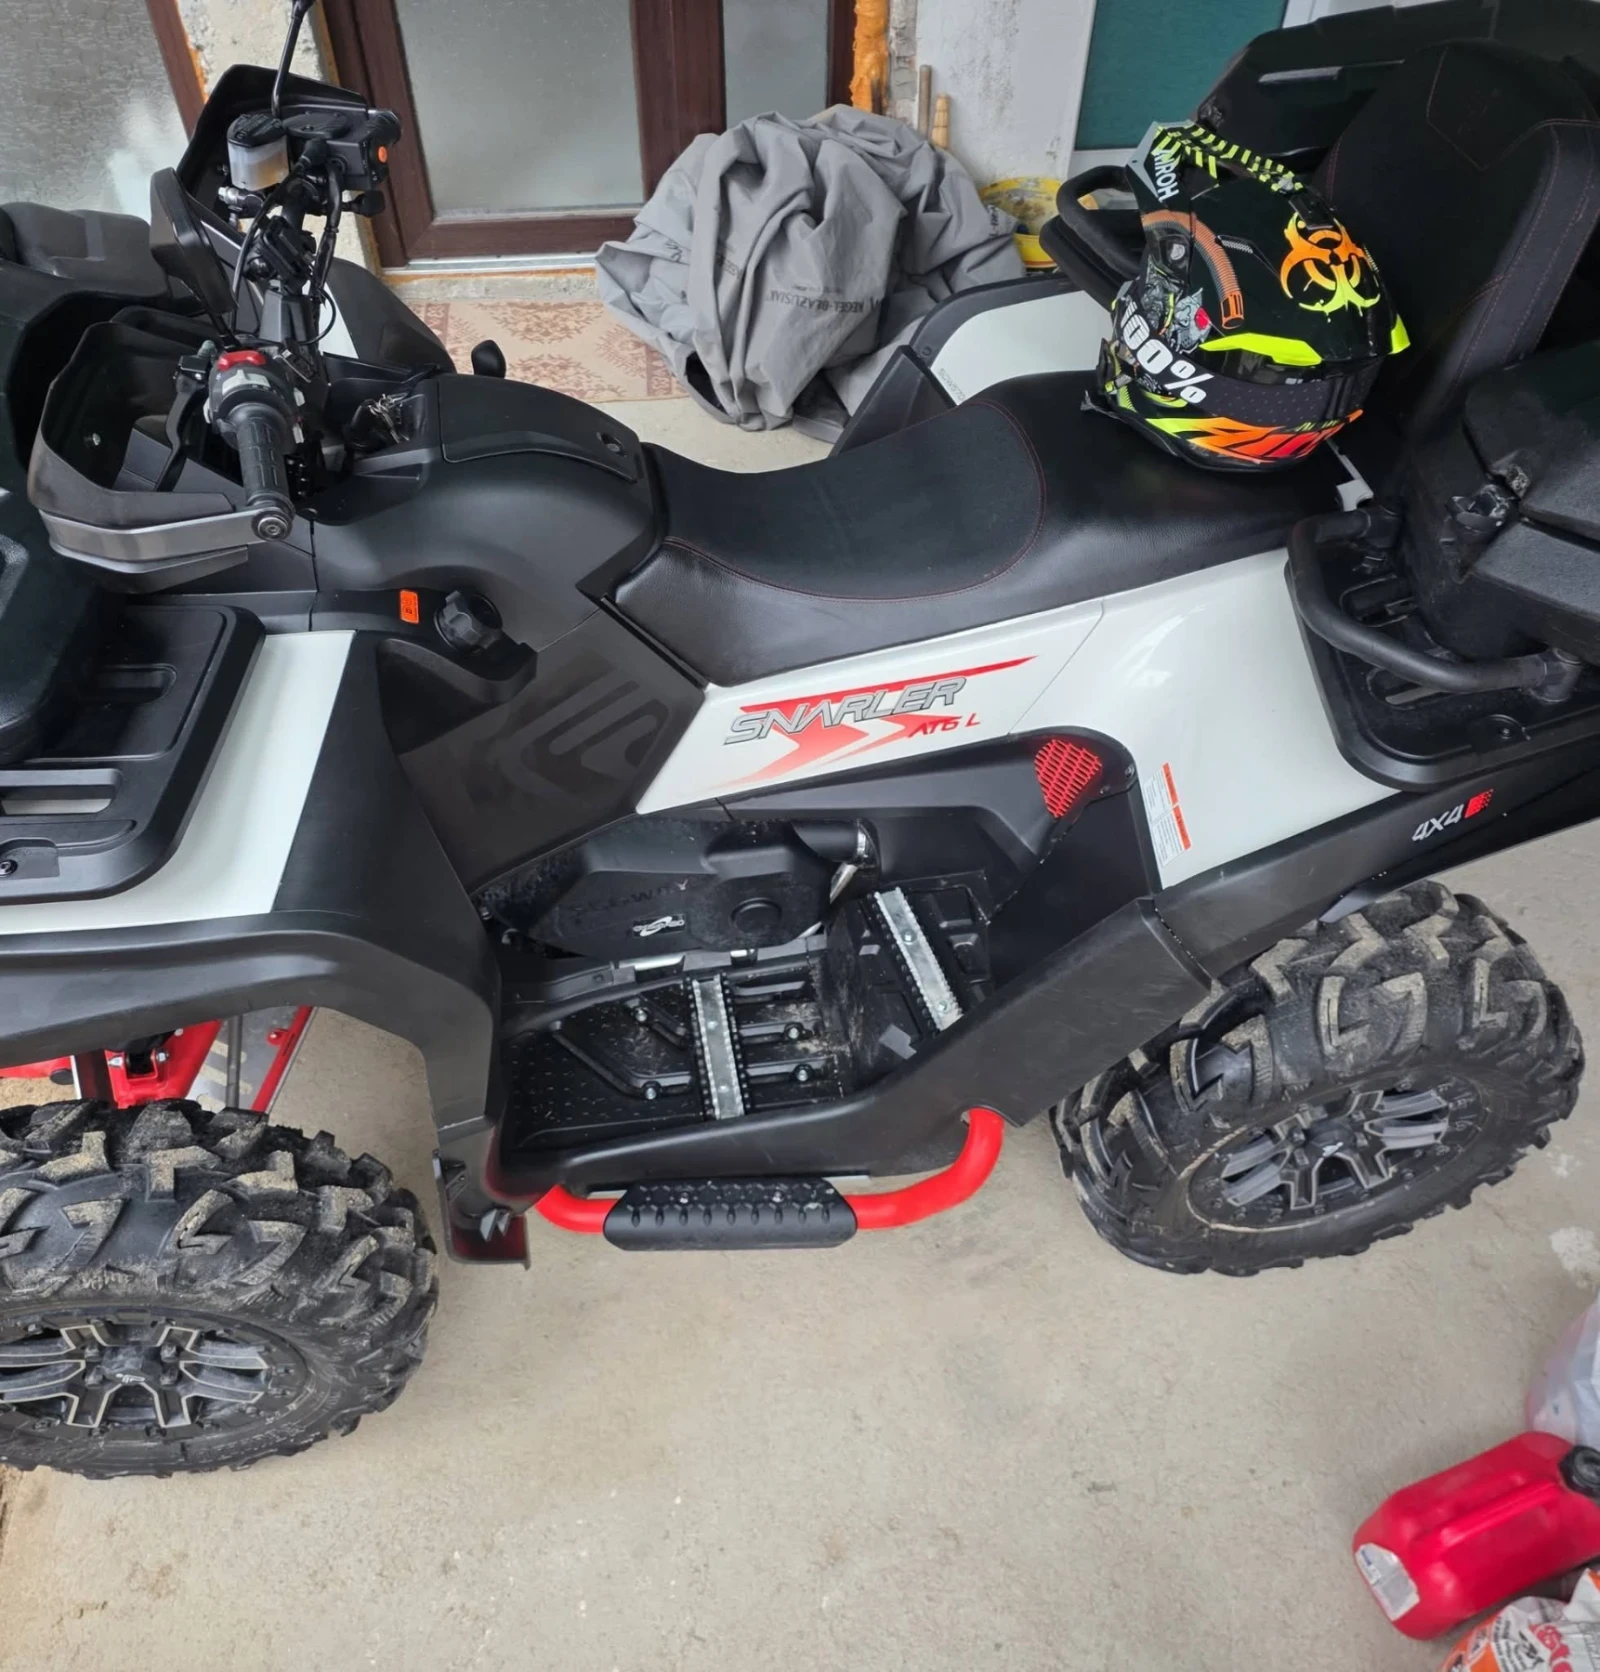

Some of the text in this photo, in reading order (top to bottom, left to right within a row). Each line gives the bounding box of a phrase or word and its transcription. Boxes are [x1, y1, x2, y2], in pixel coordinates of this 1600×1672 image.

[1120, 299, 1215, 404] 100%
[723, 677, 967, 745] SNARLER
[907, 712, 981, 738] AT6 L
